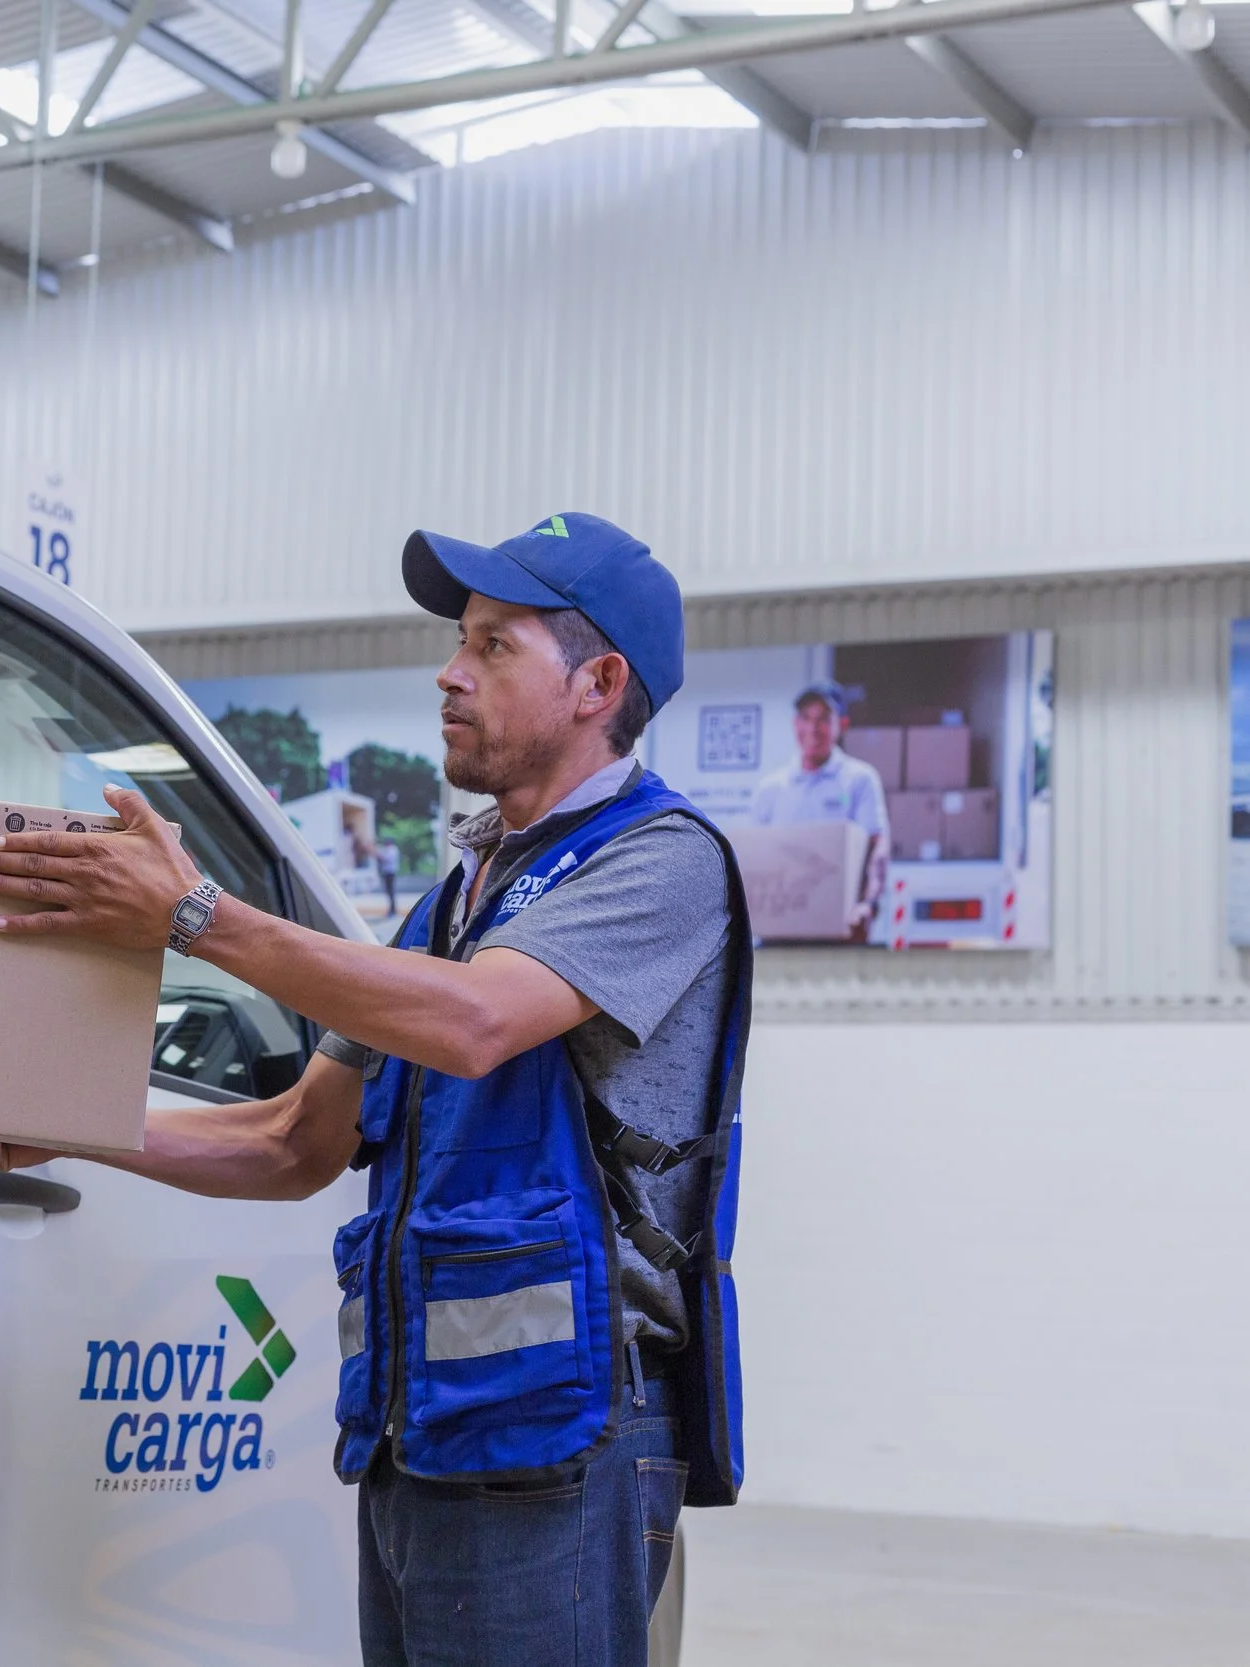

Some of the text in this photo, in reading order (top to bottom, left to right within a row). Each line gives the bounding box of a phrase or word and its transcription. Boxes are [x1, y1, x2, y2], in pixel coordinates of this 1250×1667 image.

[30, 525, 70, 585] 18
[79, 1324, 227, 1402] movi
[94, 1478, 191, 1492] TRANSPORTES
[105, 1411, 264, 1493] carga
